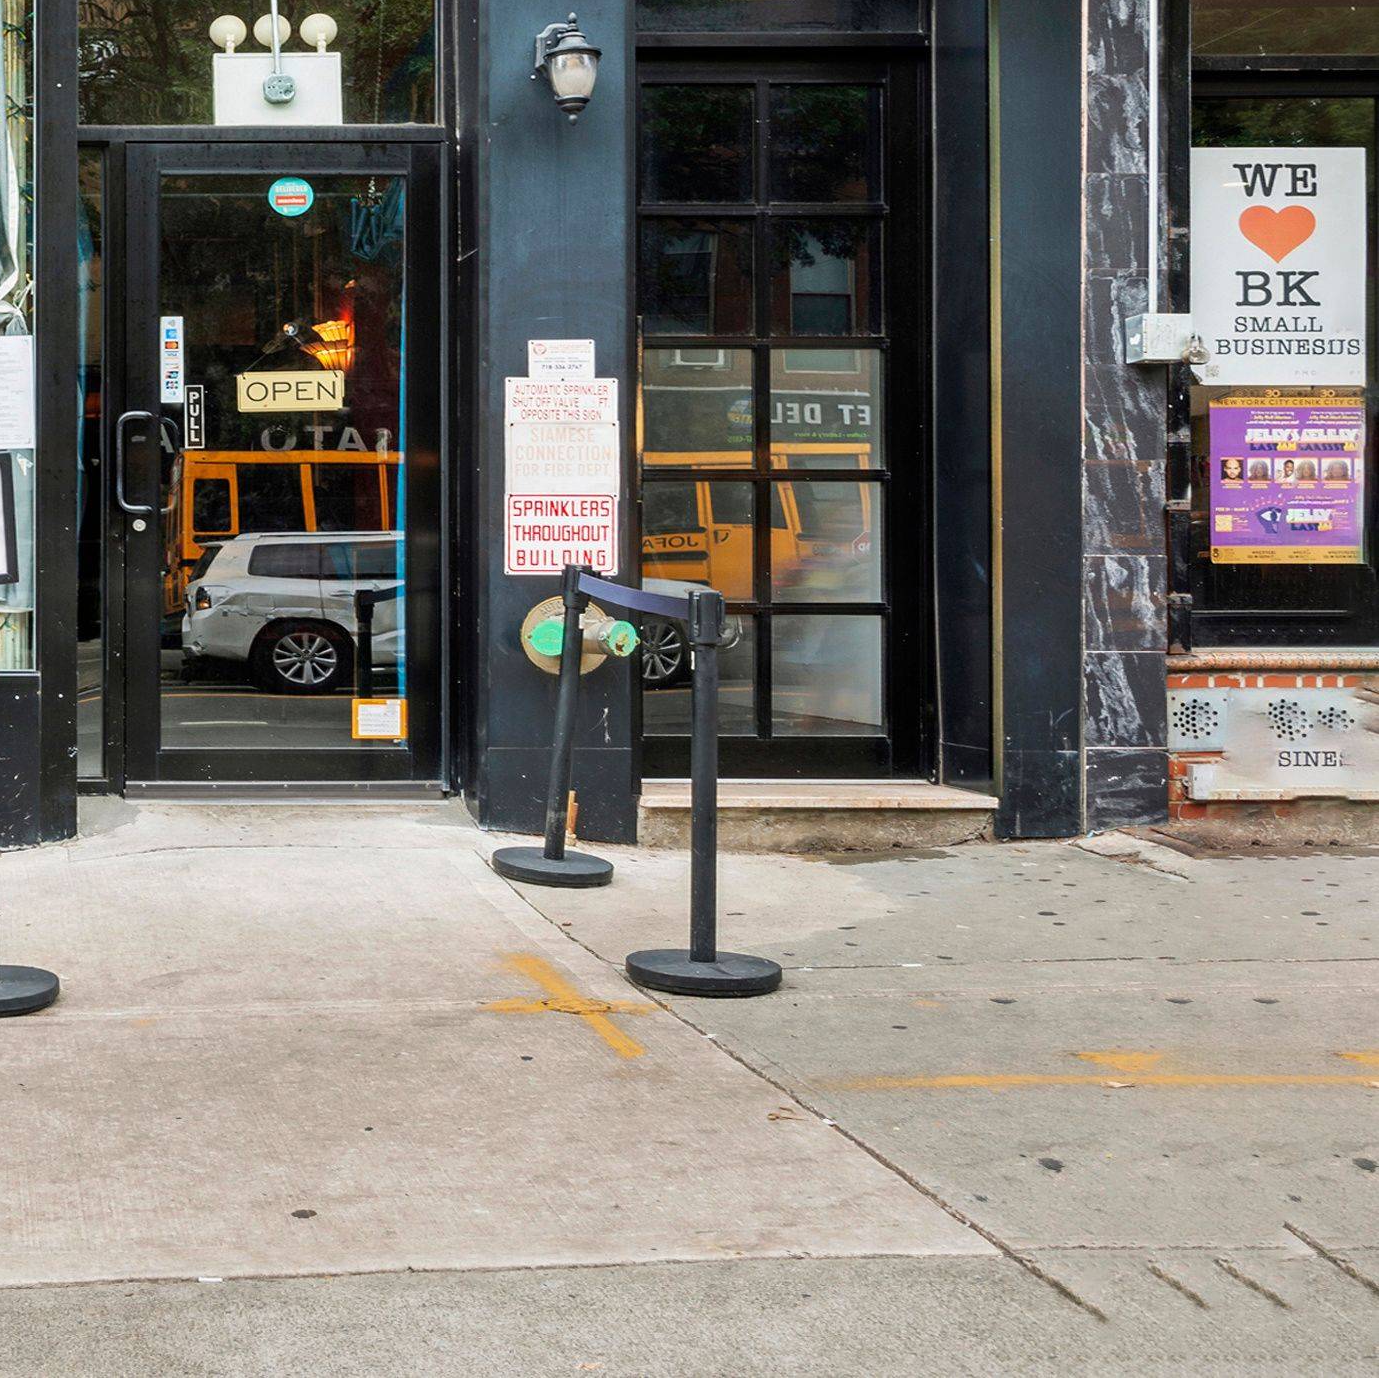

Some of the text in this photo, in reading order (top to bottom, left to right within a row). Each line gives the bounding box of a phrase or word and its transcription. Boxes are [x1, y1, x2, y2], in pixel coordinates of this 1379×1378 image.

[1233, 163, 1317, 197] WE
[1235, 270, 1321, 307] BK
[1234, 316, 1323, 333] SMALL
[246, 381, 336, 402] OPEN
[515, 385, 609, 395] AUTOMATIC SPRINKLER
[535, 397, 551, 407] OFF
[1270, 398, 1289, 406] CITY
[189, 391, 200, 443] PULL
[520, 409, 602, 420] OPPOSITE THIS SIGN
[531, 427, 595, 443] SIAMESE
[515, 446, 612, 461] CONNECTION
[515, 464, 539, 476] FOR
[544, 464, 571, 476] FIRE
[513, 501, 610, 516] SPRINKLERS
[514, 525, 609, 541] THROUGHOUT
[517, 550, 606, 566] BUILDING
[1278, 751, 1337, 767] SINE
